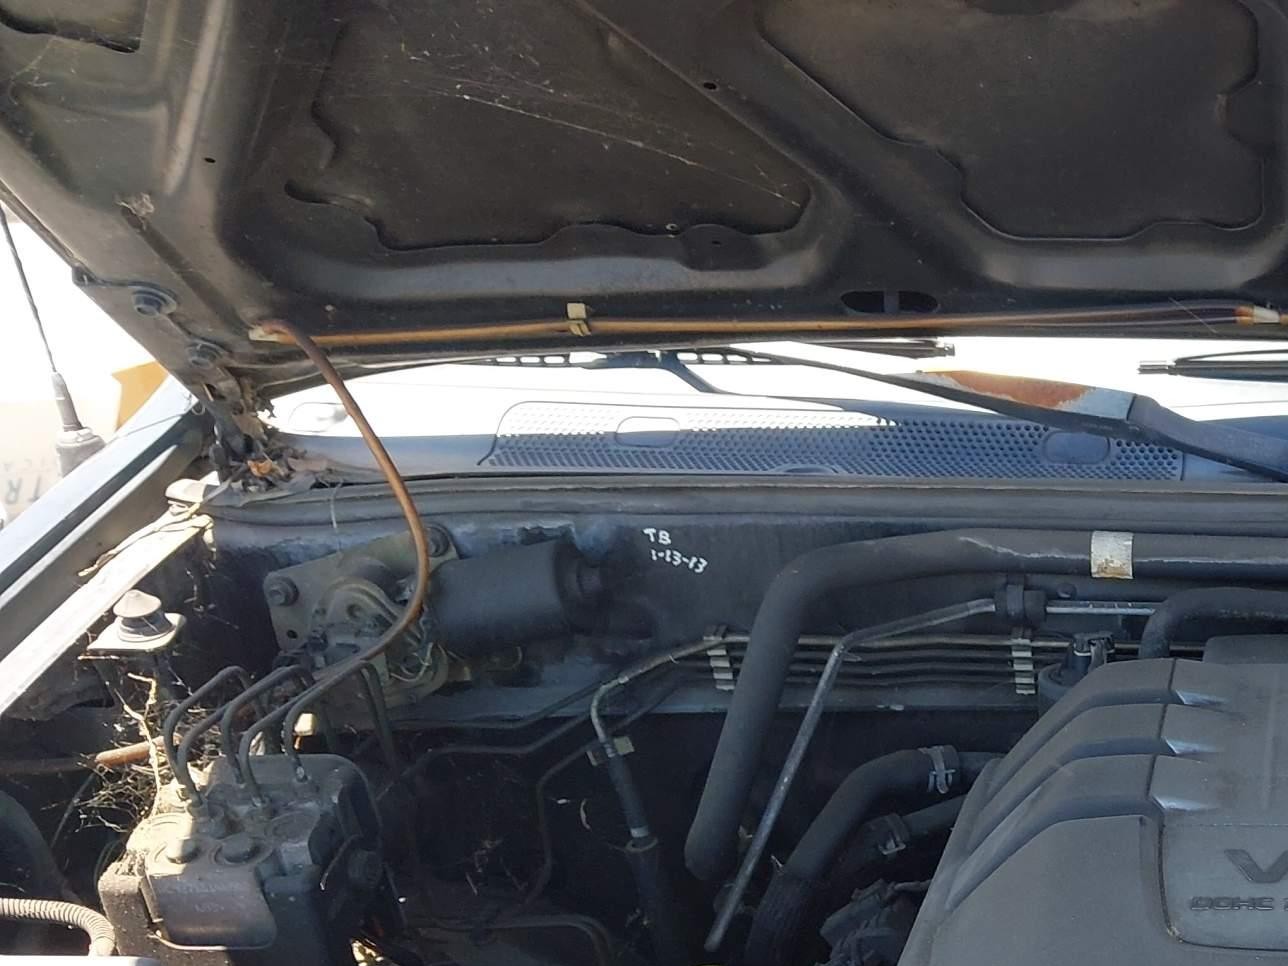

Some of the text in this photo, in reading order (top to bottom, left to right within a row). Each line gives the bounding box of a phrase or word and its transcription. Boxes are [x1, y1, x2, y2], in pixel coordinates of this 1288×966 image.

[643, 527, 672, 545] TB
[650, 548, 709, 574] 1-13-13
[1190, 895, 1275, 911] DOHC
